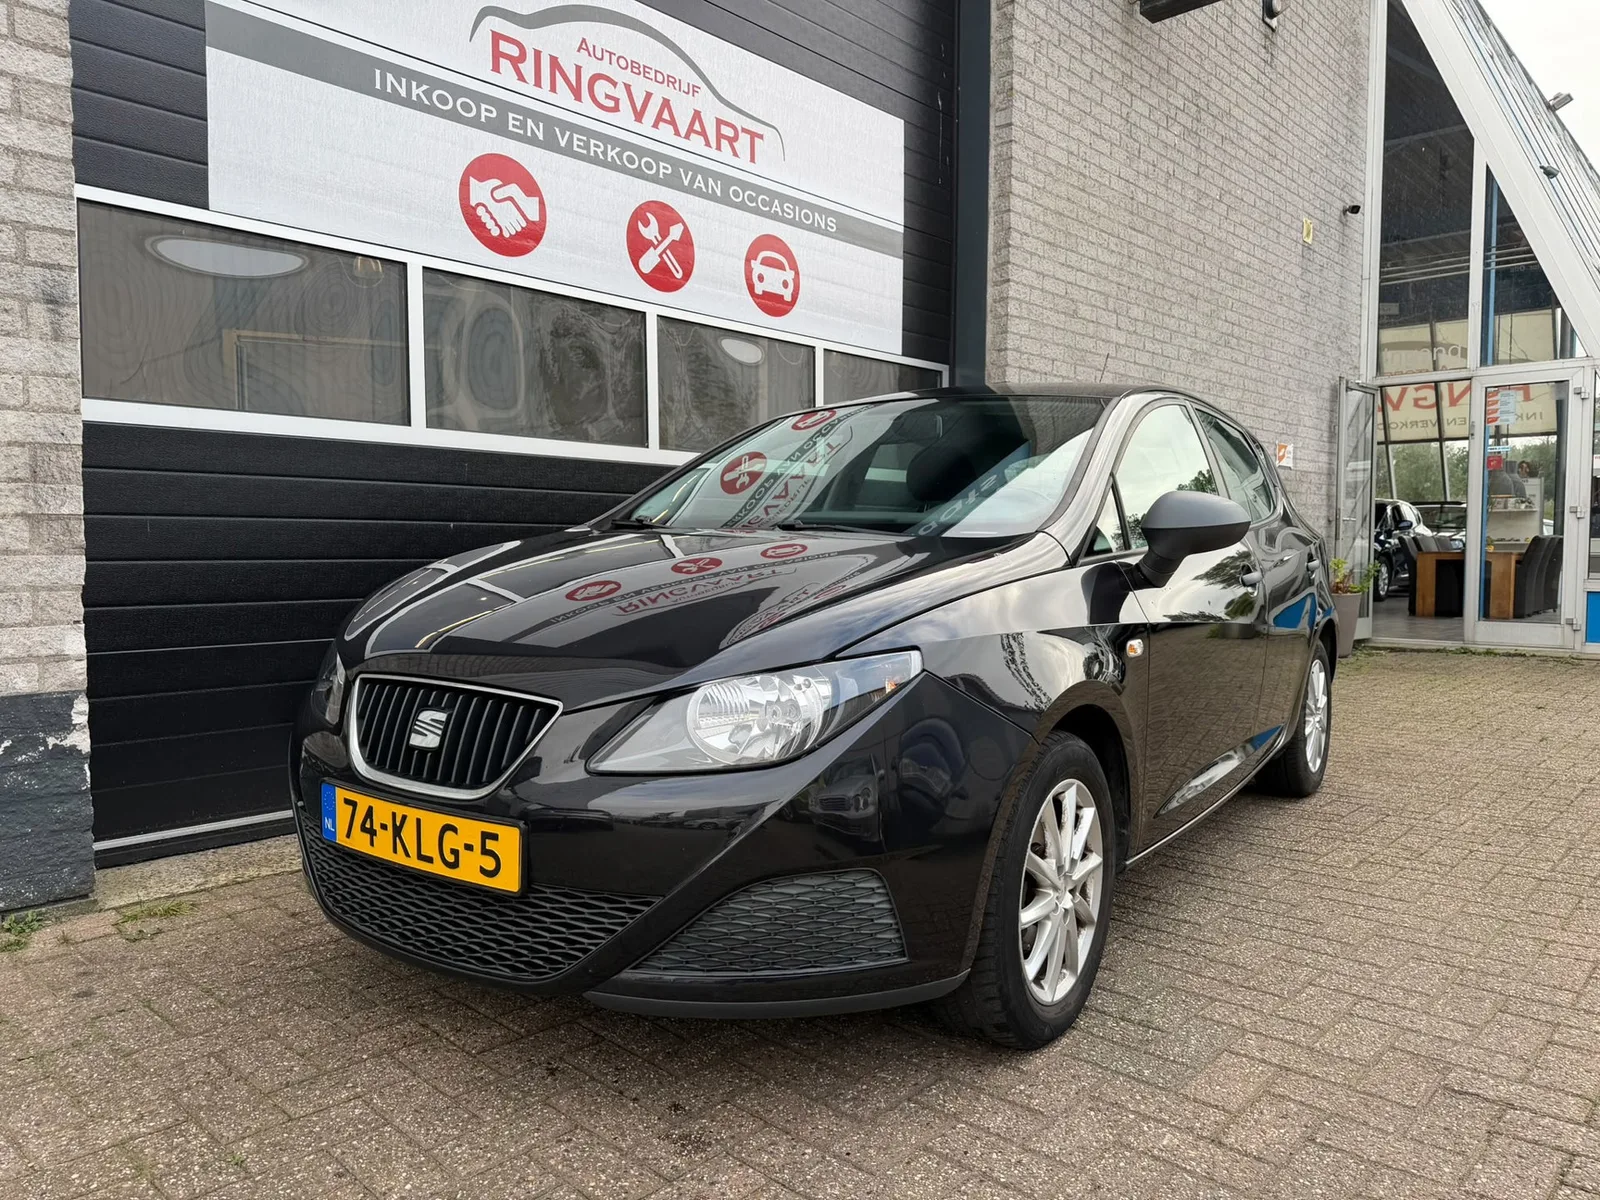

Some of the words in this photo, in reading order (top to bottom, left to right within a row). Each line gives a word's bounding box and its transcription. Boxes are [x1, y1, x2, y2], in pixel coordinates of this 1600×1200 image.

[489, 29, 765, 164] RINGVAART
[576, 37, 702, 98] AUTOBEDRIJF
[373, 68, 498, 125] INKOOP
[507, 113, 545, 141] EN
[554, 126, 673, 180] VERKOOP
[679, 168, 722, 197] VAN
[728, 185, 838, 233] OCCASIONS
[324, 816, 335, 832] NL
[343, 797, 502, 878] 74-KLG-5
